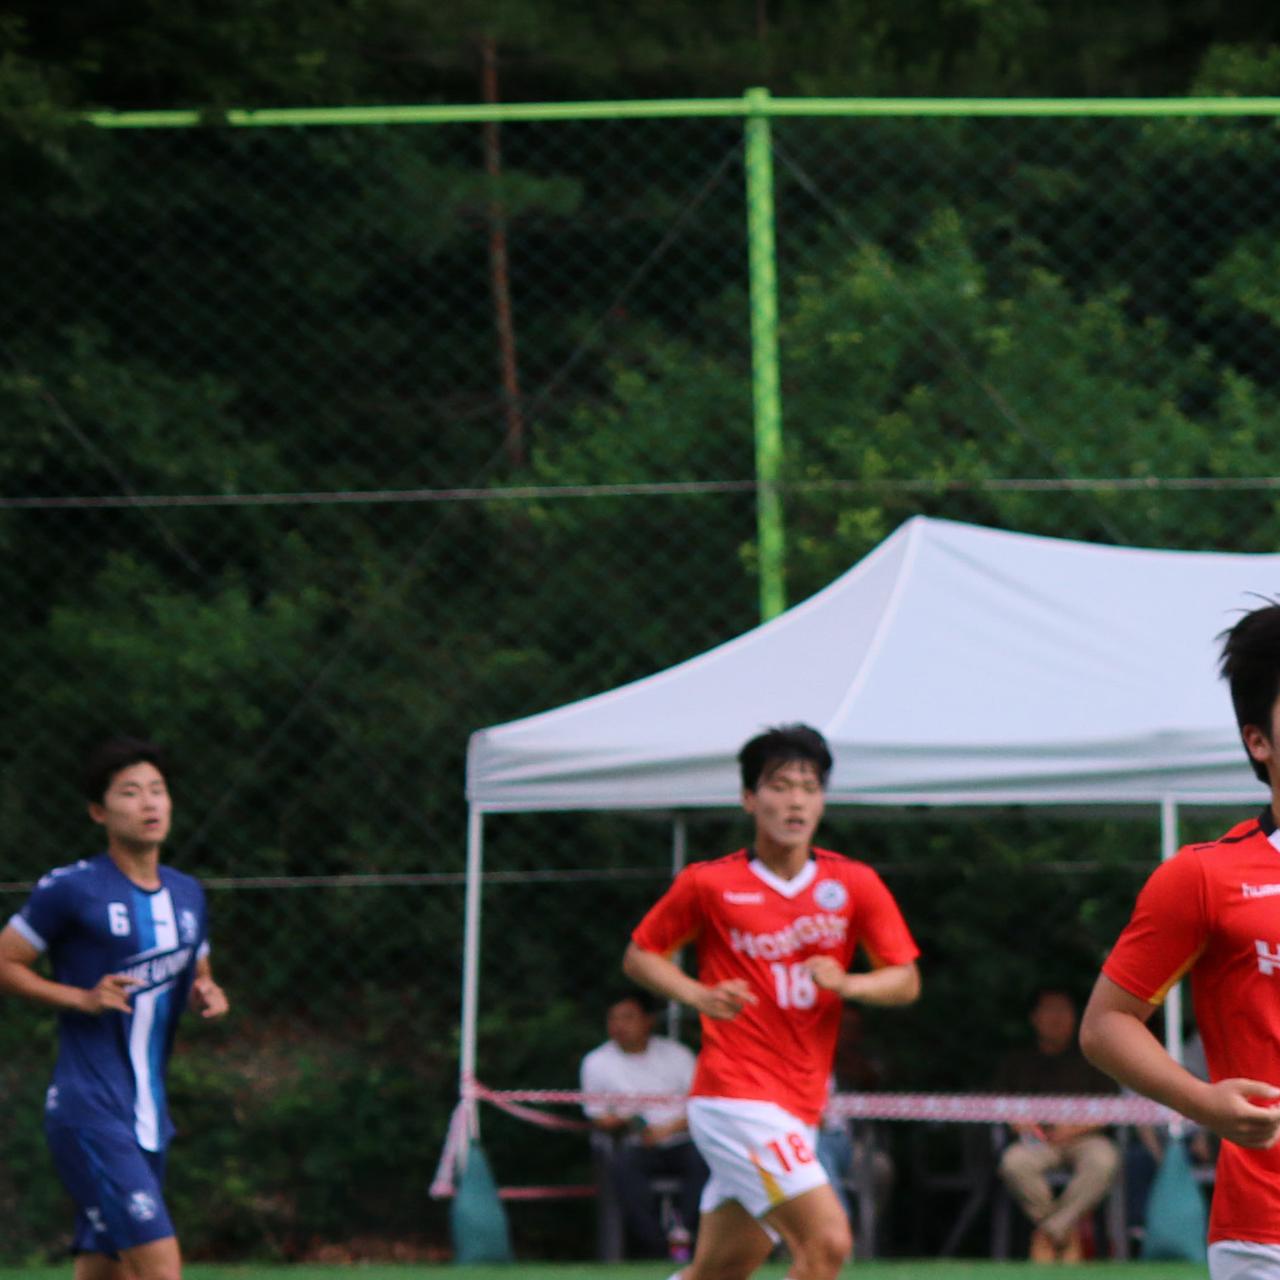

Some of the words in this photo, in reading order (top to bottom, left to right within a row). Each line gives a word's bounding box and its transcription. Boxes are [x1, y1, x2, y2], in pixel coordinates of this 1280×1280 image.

[108, 902, 130, 936] 6
[770, 962, 817, 1009] 18
[767, 1134, 816, 1174] 18
